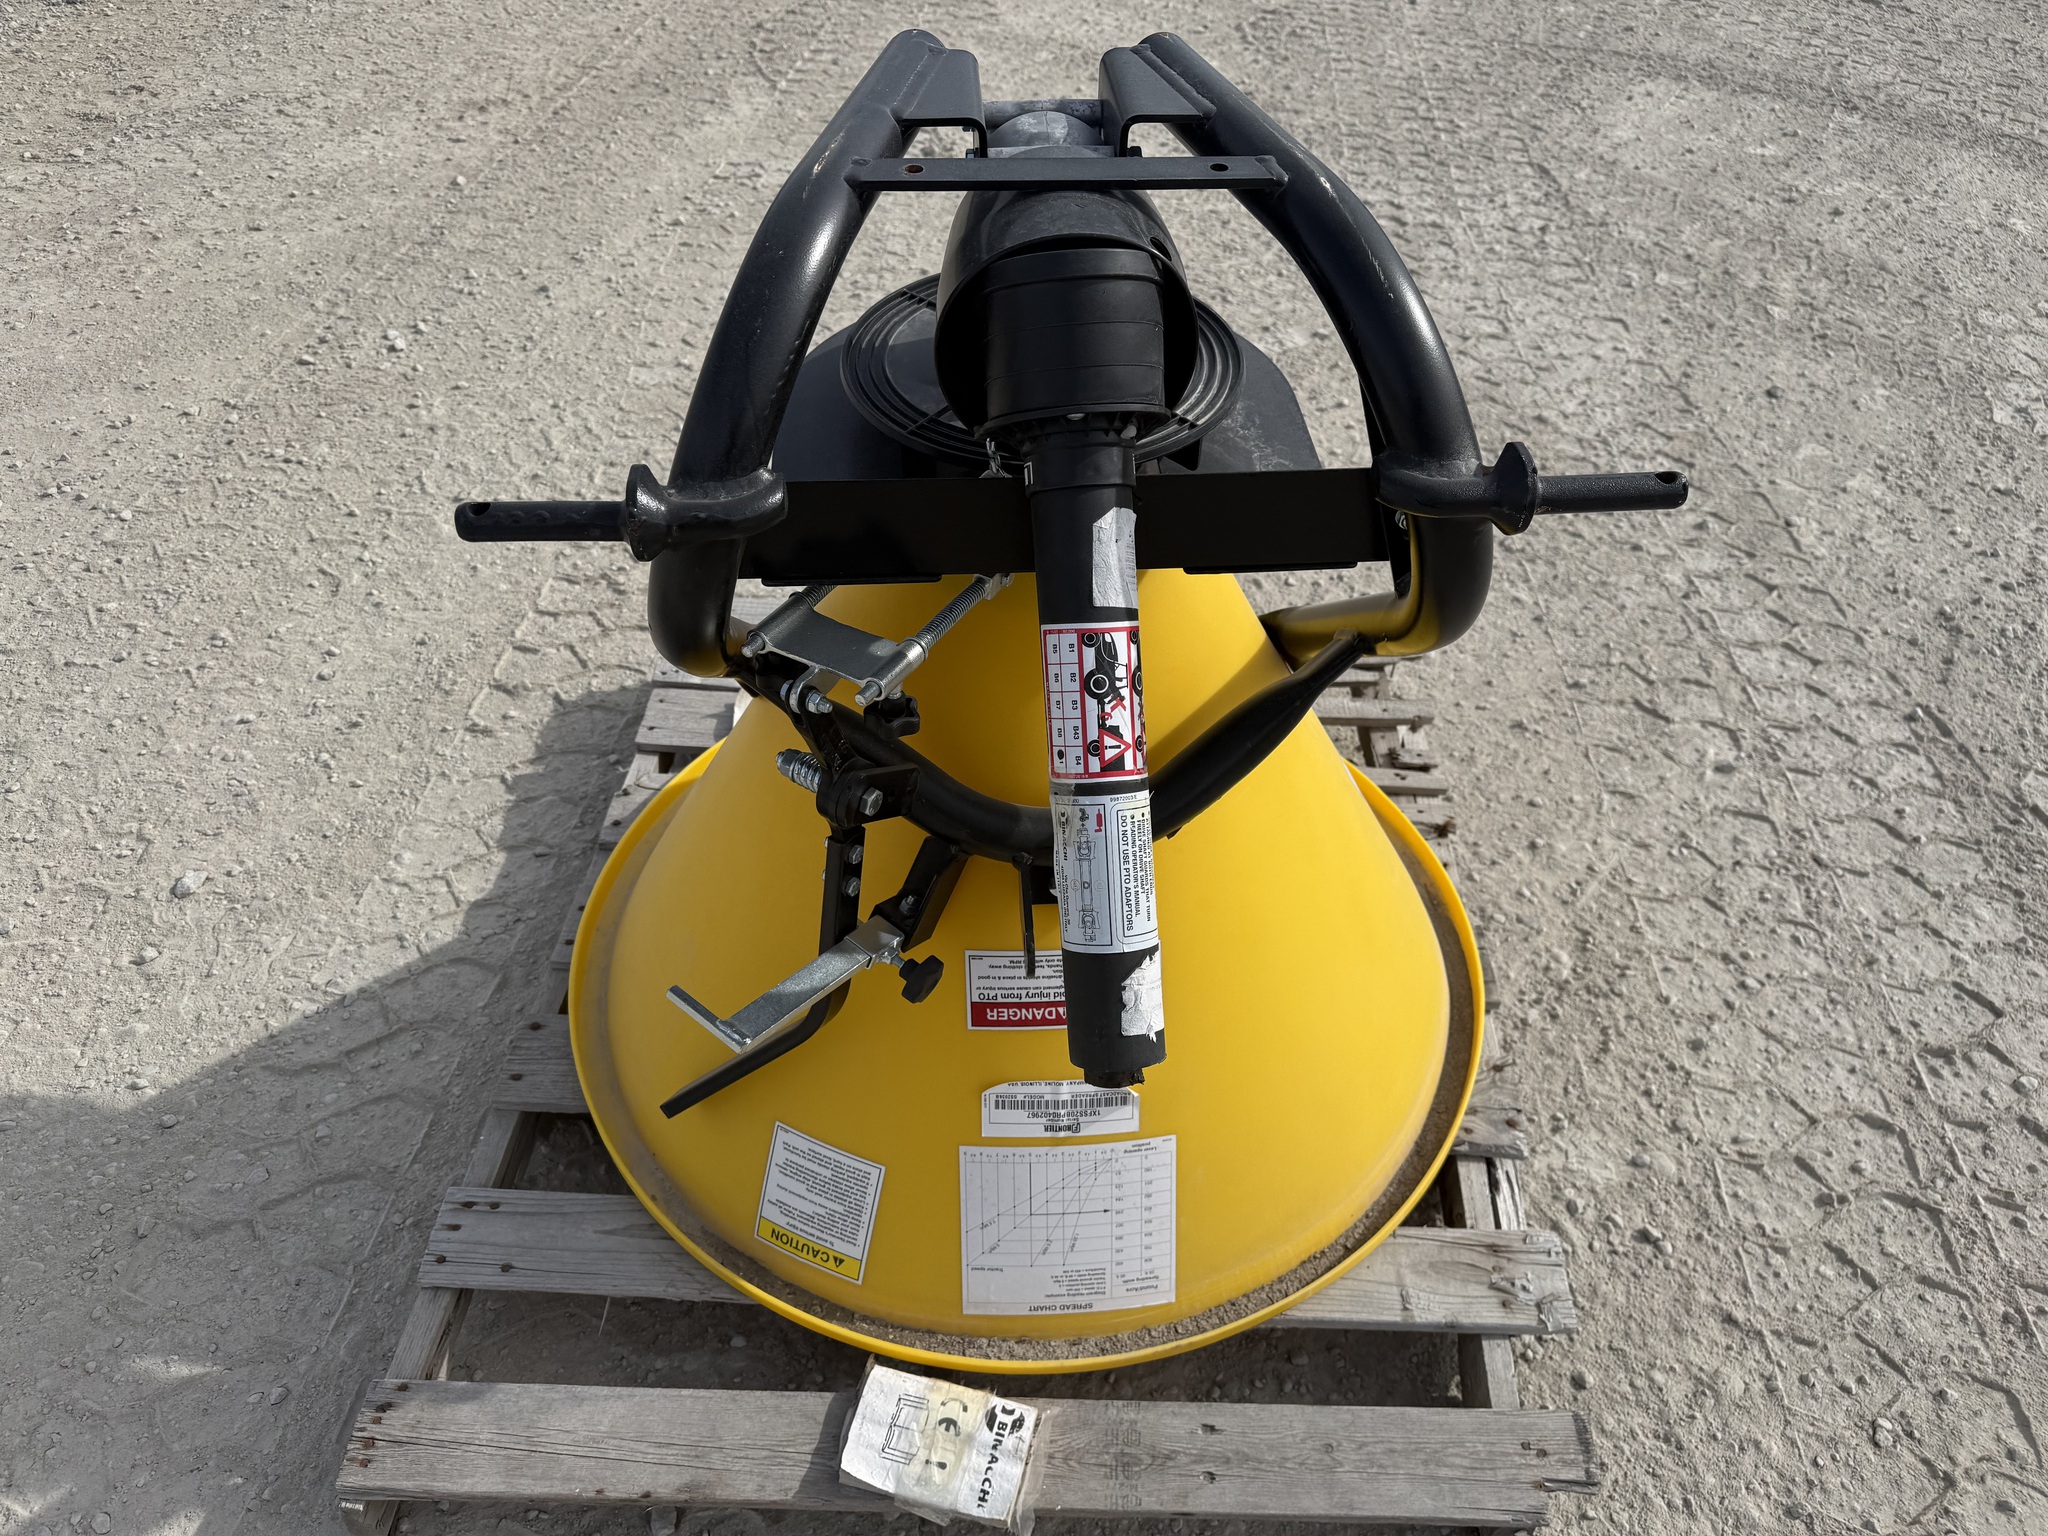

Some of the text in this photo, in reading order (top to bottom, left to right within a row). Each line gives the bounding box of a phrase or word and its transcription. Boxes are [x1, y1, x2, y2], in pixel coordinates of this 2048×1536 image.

[1070, 672, 1076, 682] B2
[1072, 700, 1078, 710] B3
[1138, 844, 1142, 852] ON
[1120, 815, 1127, 827] DO
[1124, 886, 1133, 931] ADAPTORS
[1024, 990, 1050, 1000] injury
[986, 1007, 1055, 1020] DANGER
[1043, 1122, 1080, 1133] FRONTIER
[770, 1227, 830, 1264] CAUTION
[976, 1420, 1009, 1509] BINACCHI
